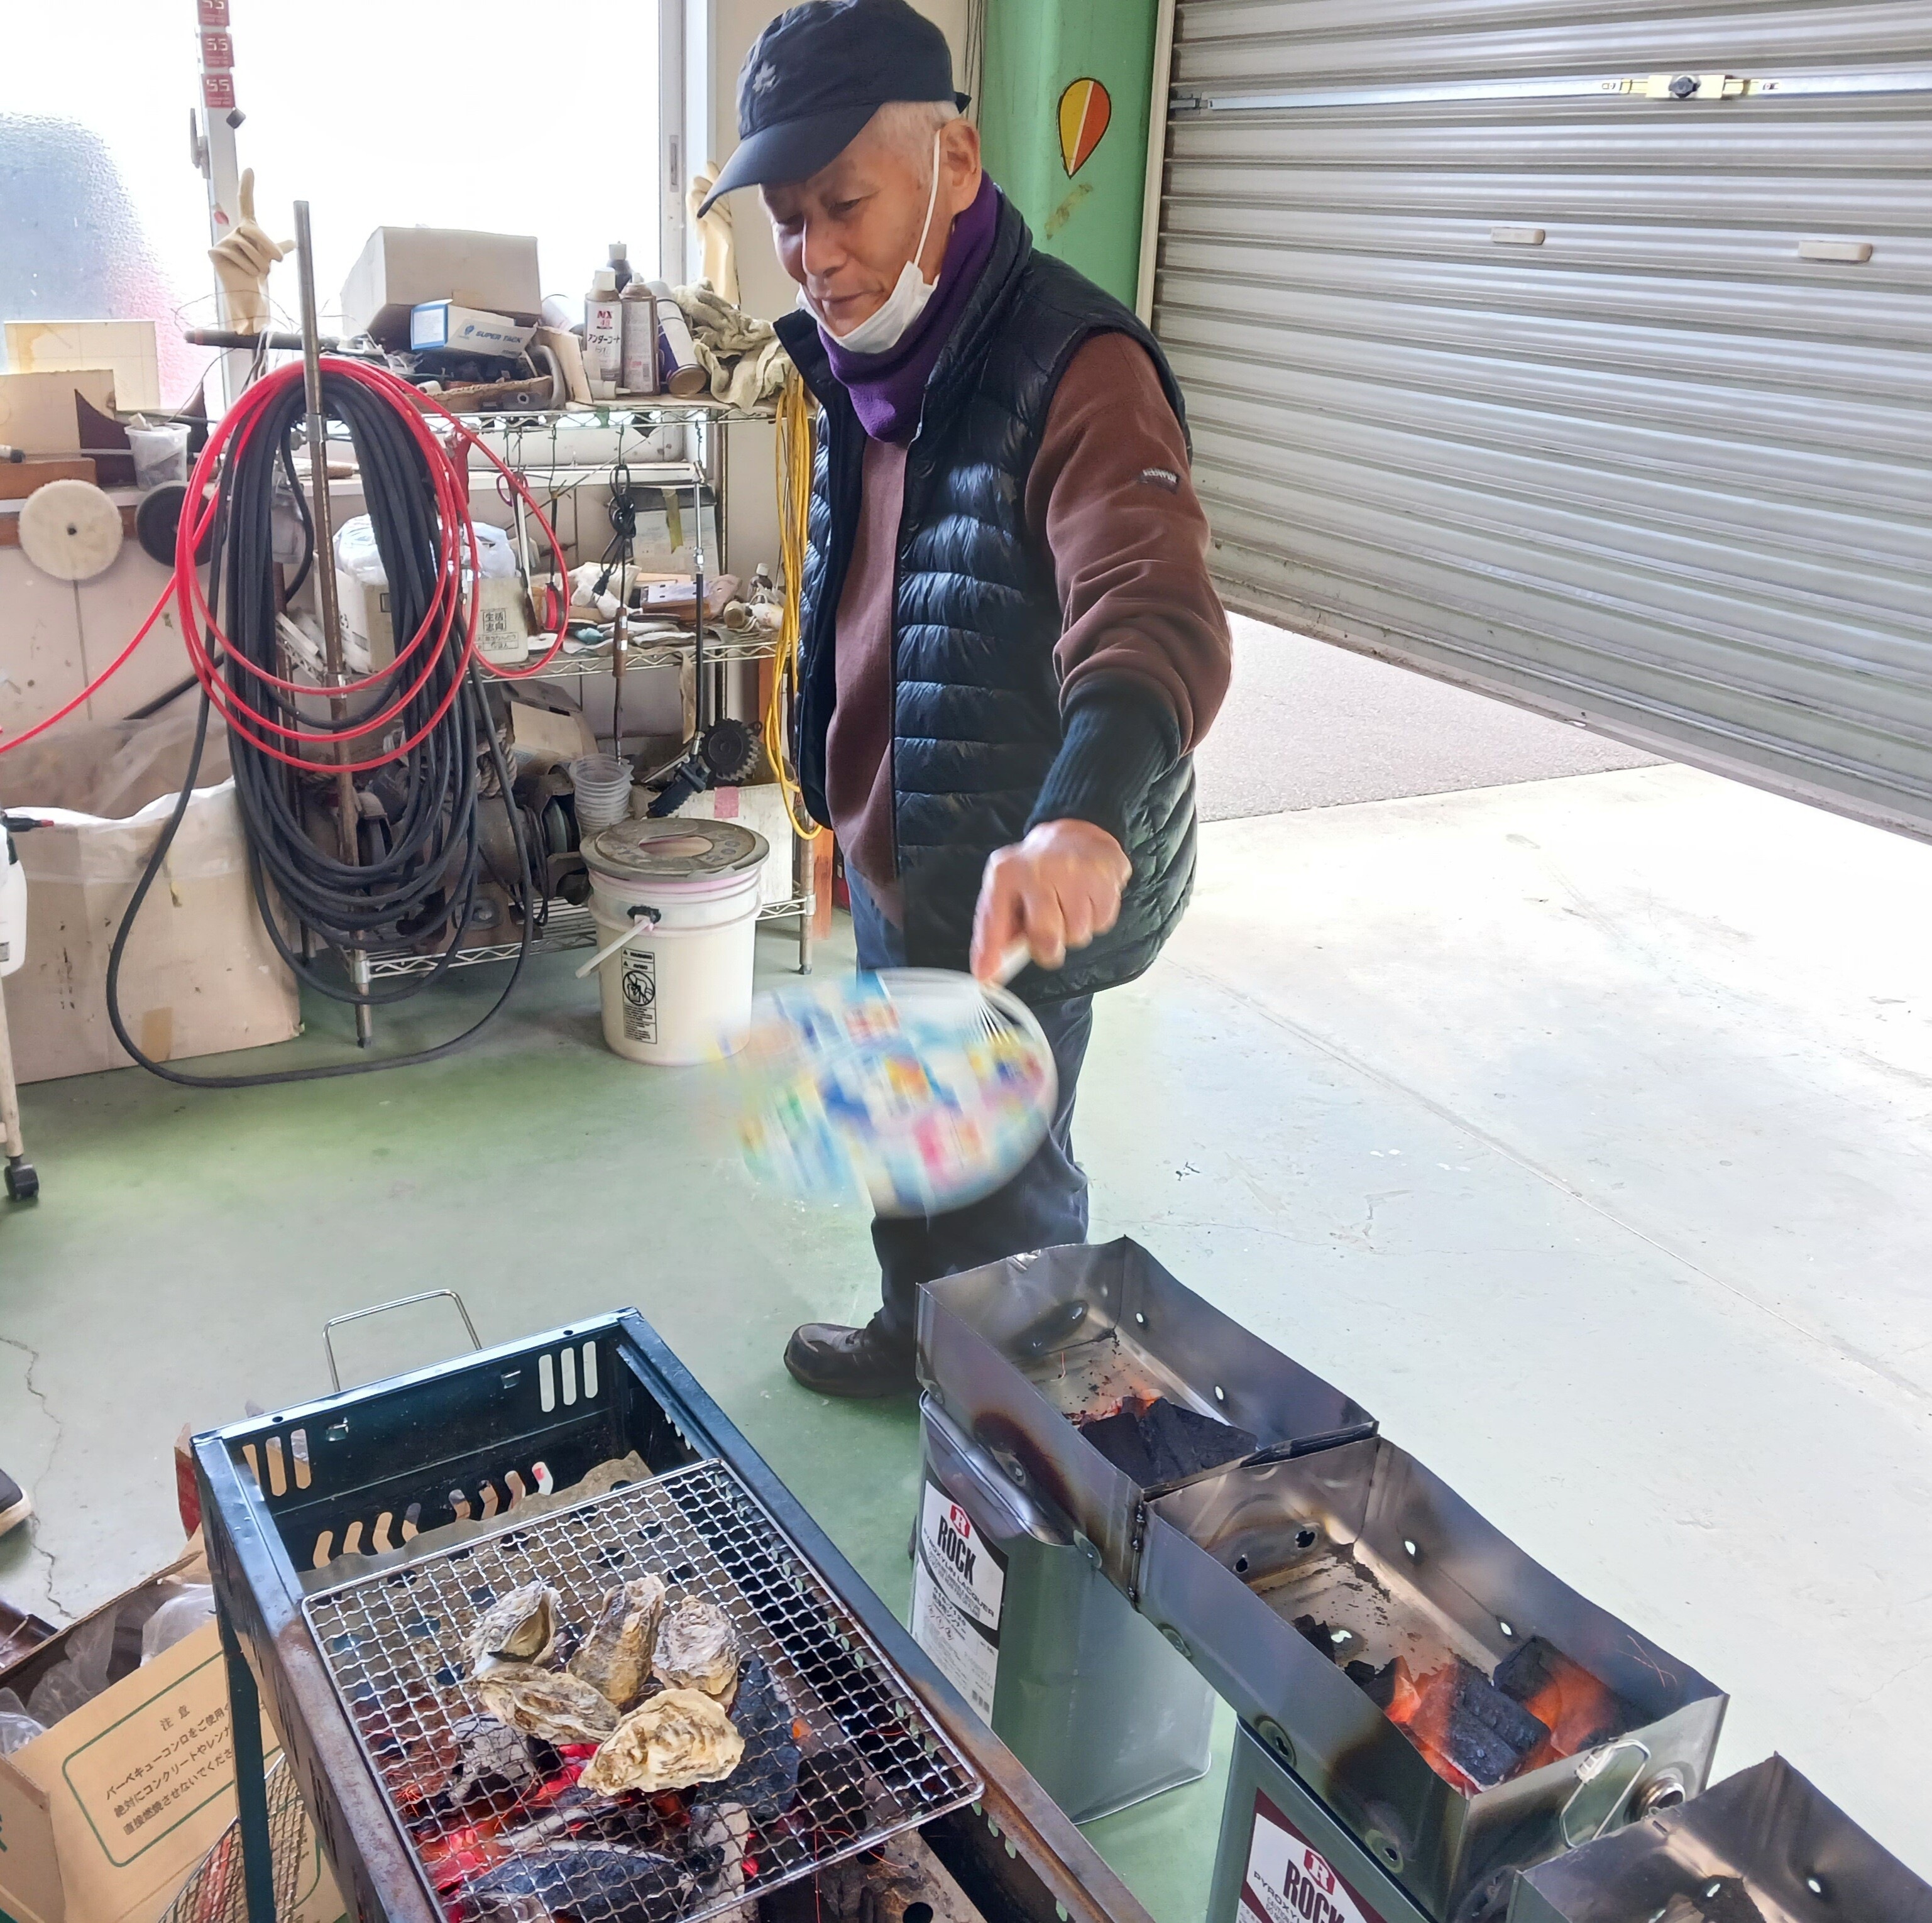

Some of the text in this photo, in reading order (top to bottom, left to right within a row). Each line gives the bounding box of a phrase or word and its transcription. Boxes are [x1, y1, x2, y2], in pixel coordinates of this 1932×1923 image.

[476, 331, 502, 340] SUPER
[503, 335, 523, 343] TACK
[588, 334, 621, 344] アンダーコート
[937, 1515, 976, 1586] ROCK
[957, 1573, 994, 1618] LACQUER
[159, 1704, 190, 1731] 注意
